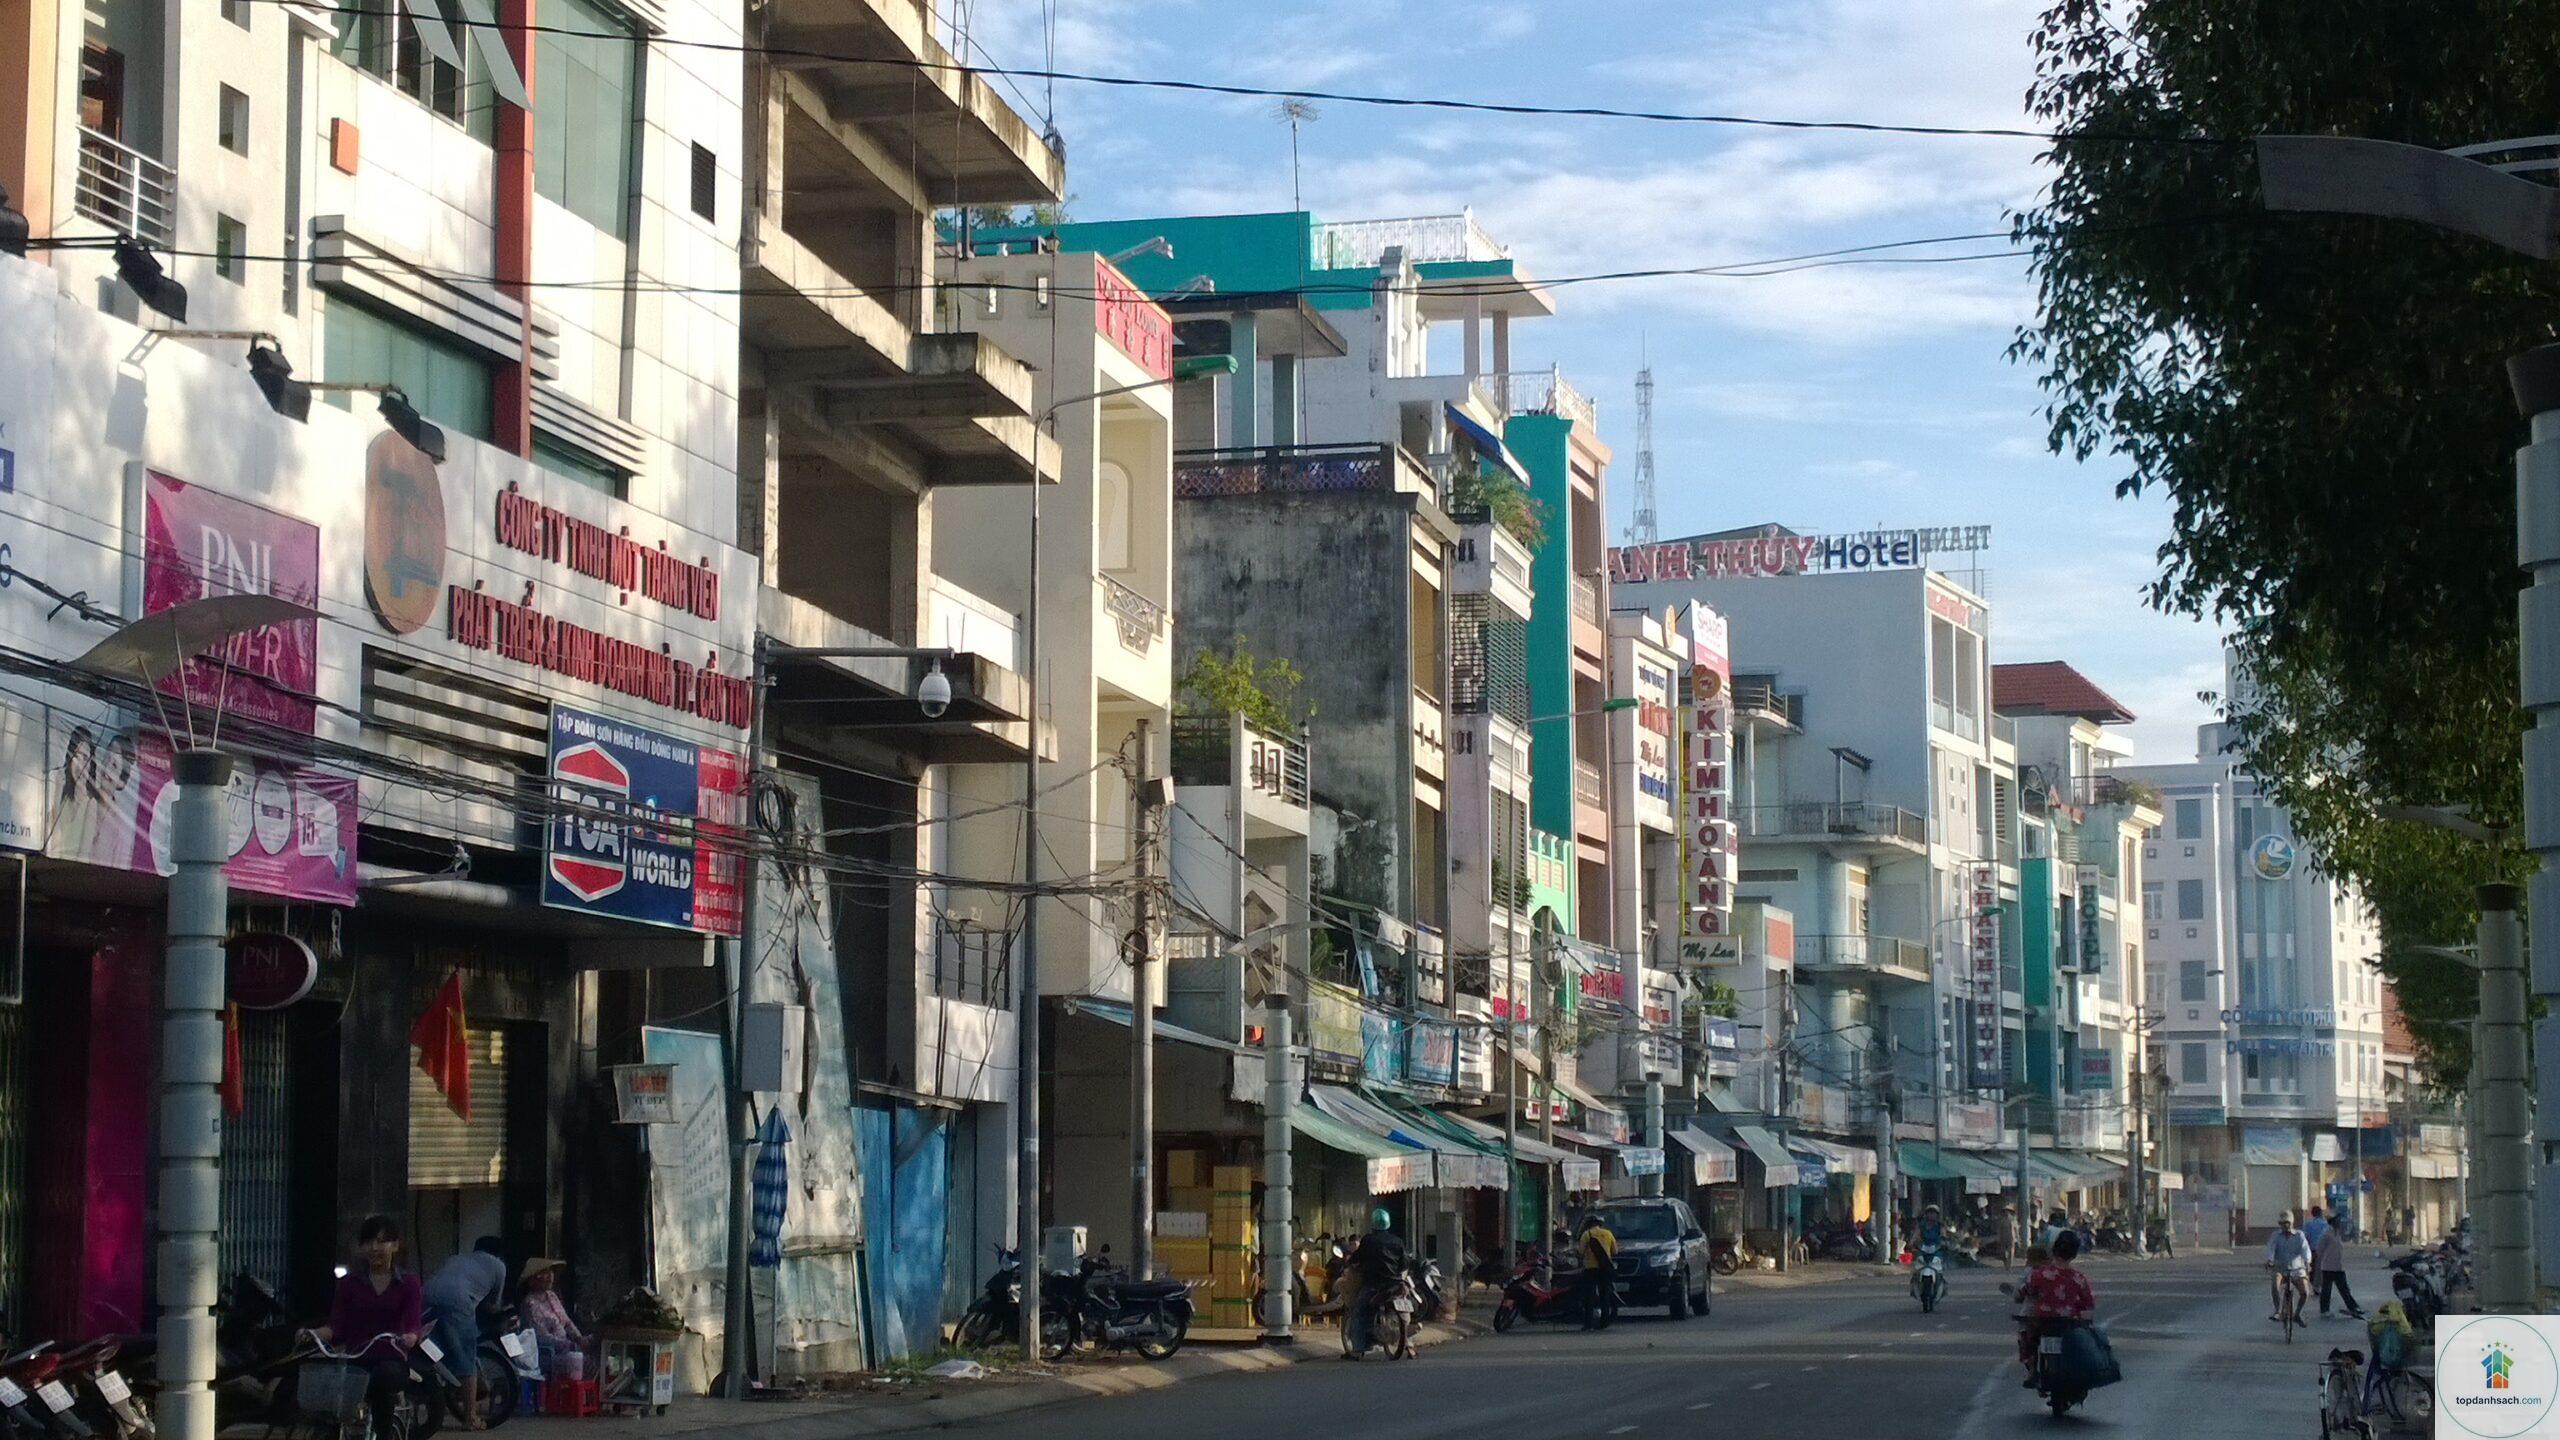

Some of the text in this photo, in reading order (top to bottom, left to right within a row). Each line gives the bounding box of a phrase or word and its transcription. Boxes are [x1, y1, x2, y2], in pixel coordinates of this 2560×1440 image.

[495, 480, 718, 621] CÔNG TY TNHH MỘT THÀNH VIÊN
[1824, 533, 1918, 569] Hotel
[447, 579, 496, 650] PHÁT
[496, 580, 543, 666] TRIỂN
[542, 615, 557, 671] &
[557, 621, 595, 682] KINH
[594, 632, 645, 697] DOANH
[644, 642, 673, 707] NHÀ
[673, 660, 695, 713] TP.
[696, 650, 725, 722] CẦN
[559, 786, 621, 857] TOA
[632, 848, 691, 890] WORLD
